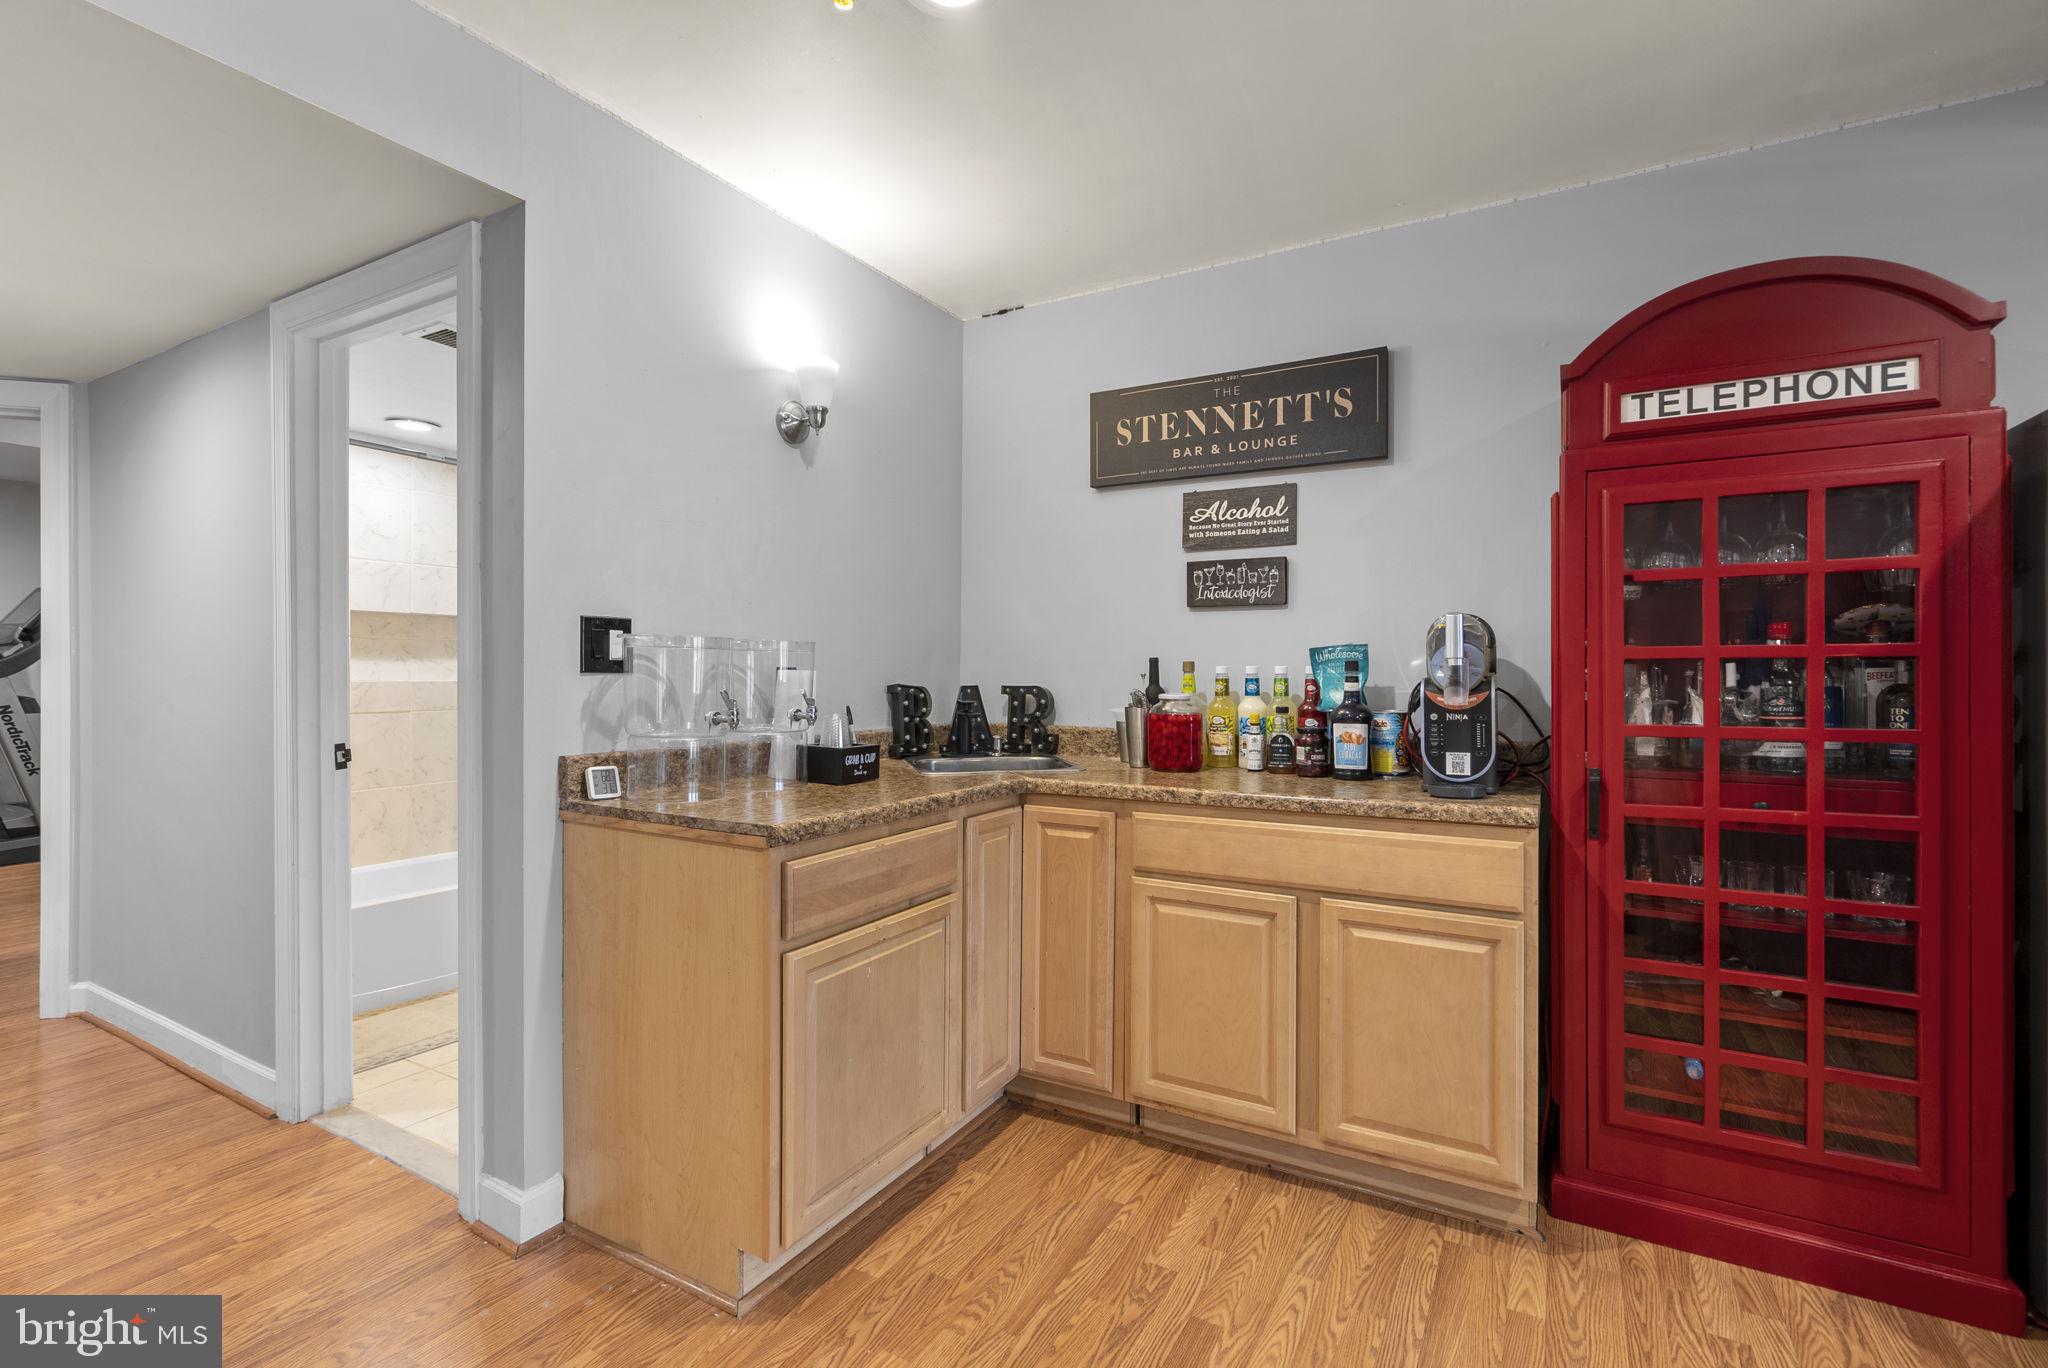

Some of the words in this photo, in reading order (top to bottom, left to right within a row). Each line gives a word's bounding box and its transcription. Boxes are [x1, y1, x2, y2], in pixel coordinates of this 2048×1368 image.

[1213, 385, 1241, 398] THE
[1630, 360, 1908, 420] TELEPHONE
[1116, 387, 1354, 447] STENNETT'S
[1172, 446, 1203, 459] BAR
[1211, 444, 1220, 455] &
[1229, 434, 1299, 452] LOUNGE
[1189, 495, 1289, 523] Alcohol
[1188, 531, 1204, 539] with
[1205, 528, 1236, 537] Someone
[1237, 526, 1261, 535] Eating
[1268, 525, 1289, 533] Salad
[1195, 583, 1277, 604] Intoxicologist
[1315, 647, 1364, 663] Wholesome
[1867, 671, 1898, 682] BEEFEA
[887, 684, 1059, 757] BAR
[1446, 713, 1469, 723] NINJA
[0, 704, 40, 777] NordicTrack
[845, 754, 860, 766] GRAB
[860, 753, 865, 764] A
[864, 752, 877, 764] CUP
